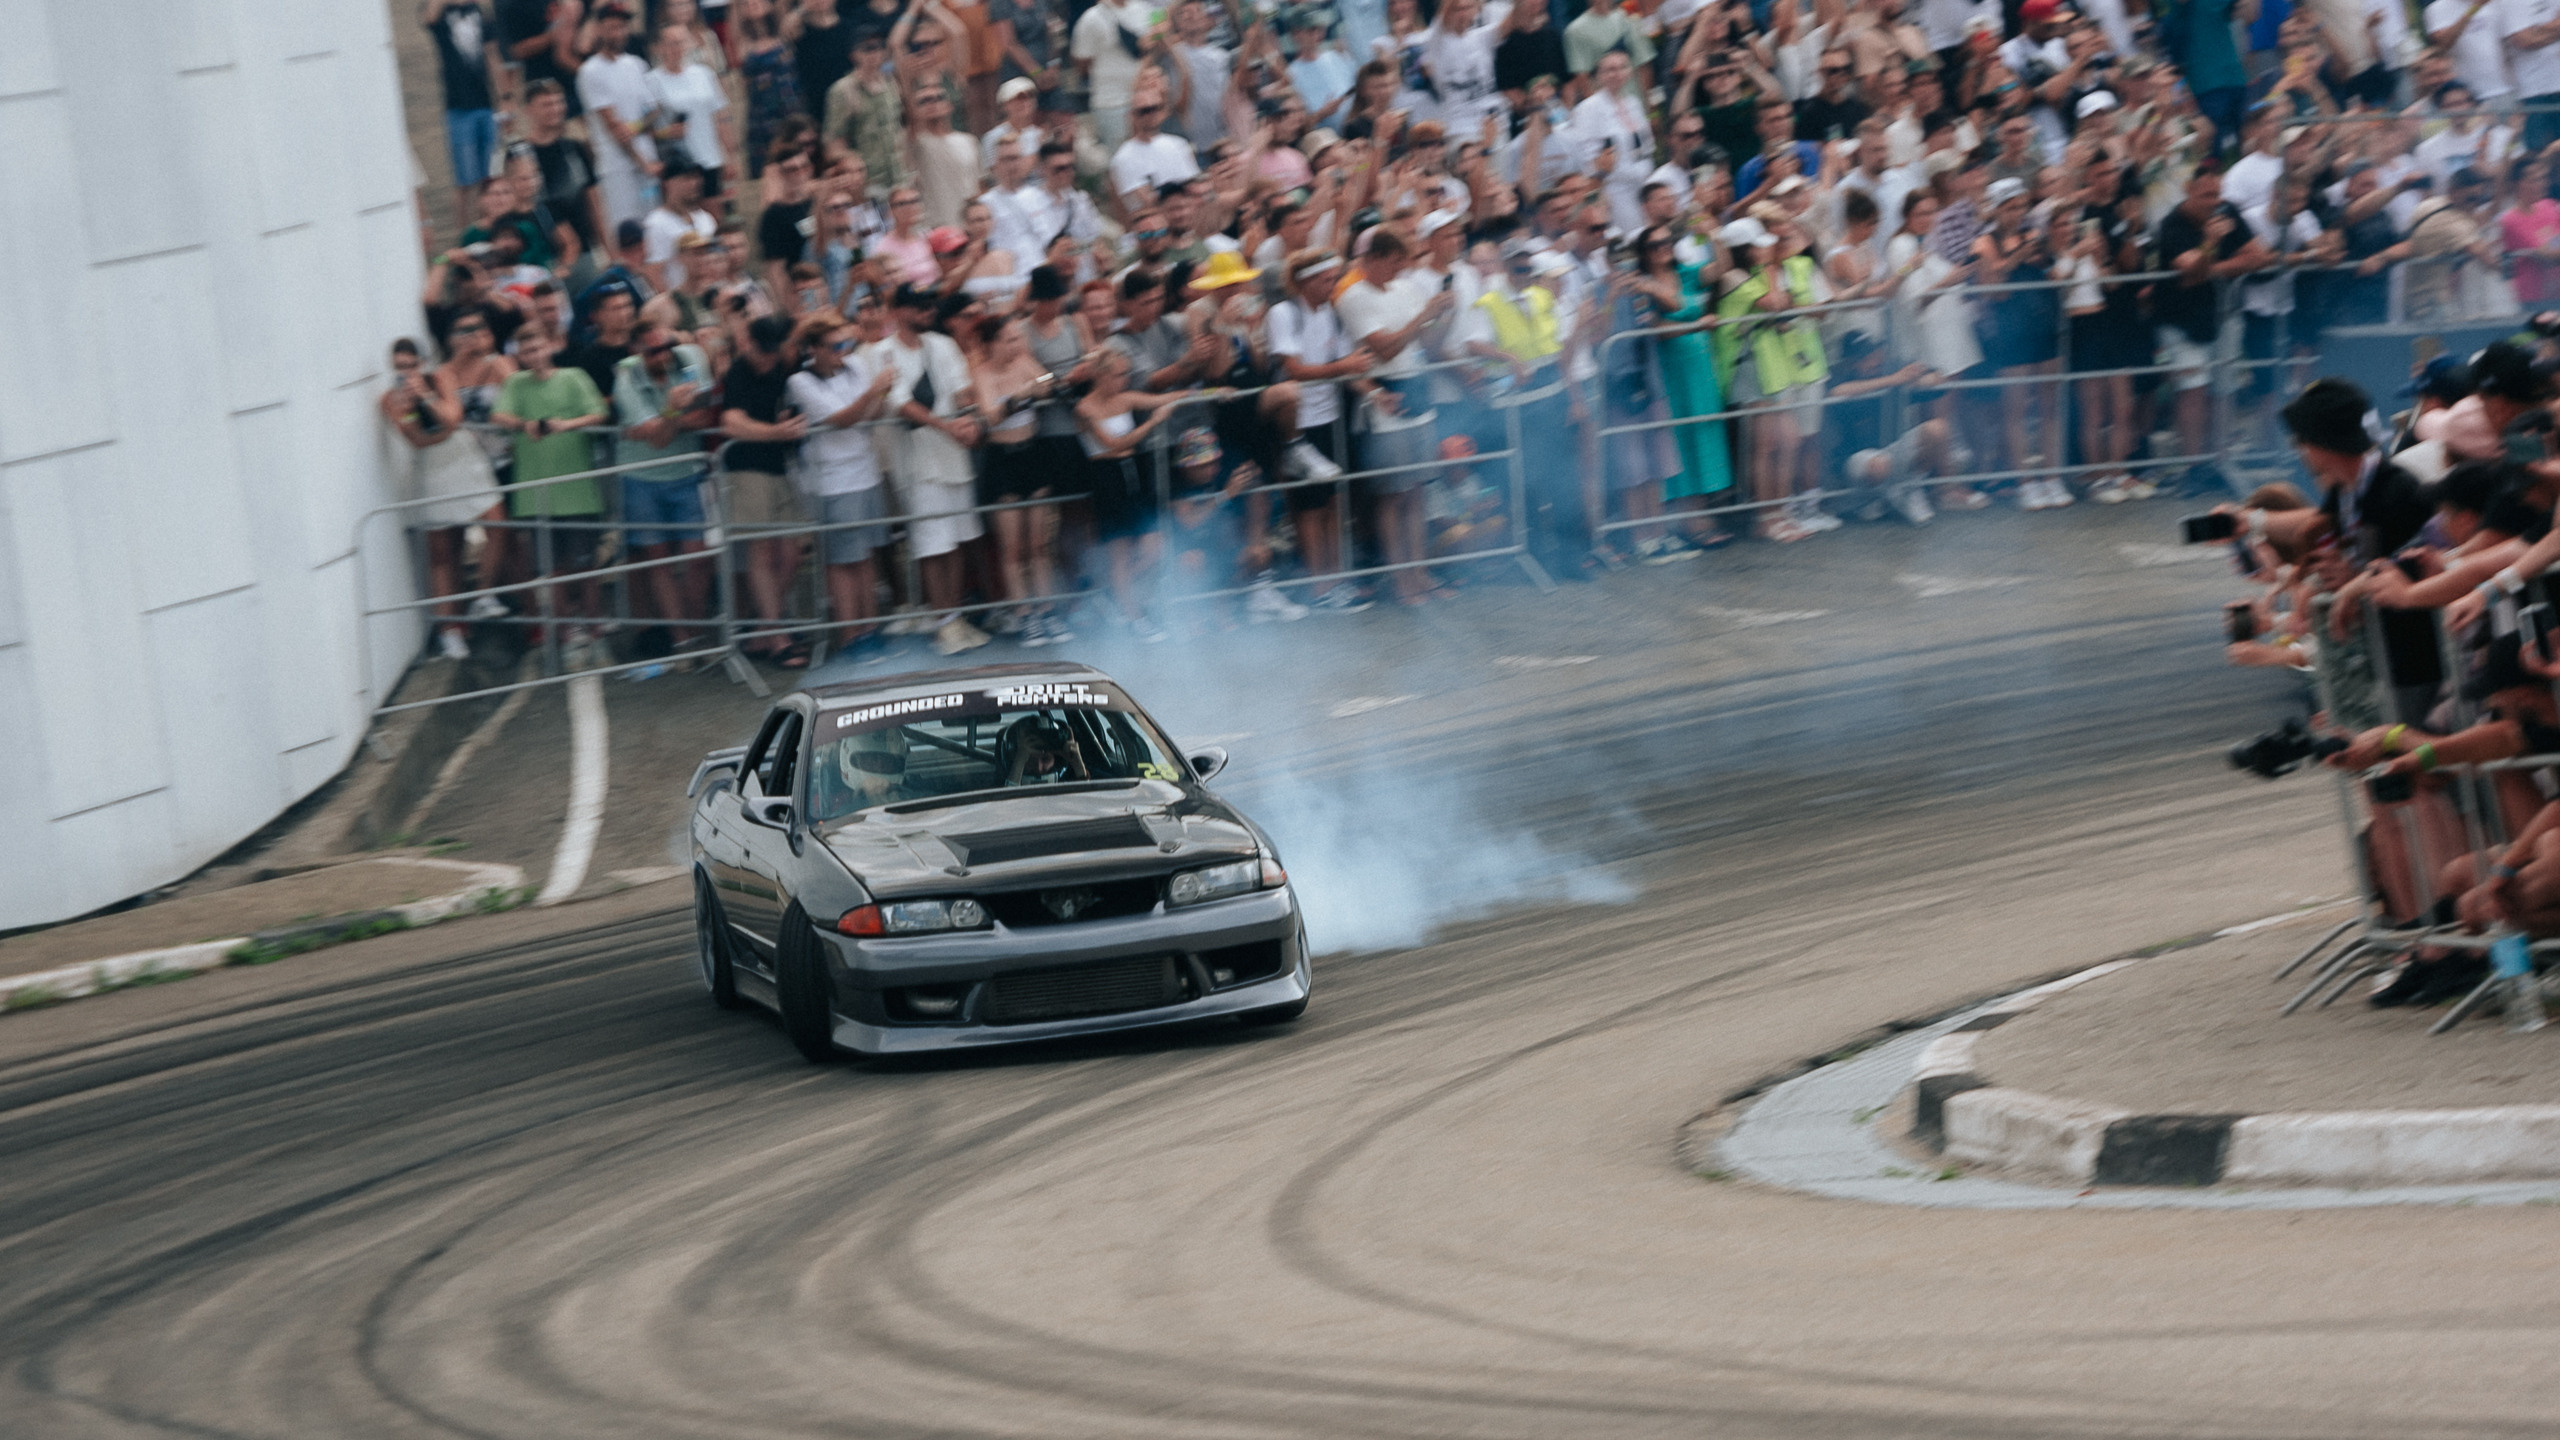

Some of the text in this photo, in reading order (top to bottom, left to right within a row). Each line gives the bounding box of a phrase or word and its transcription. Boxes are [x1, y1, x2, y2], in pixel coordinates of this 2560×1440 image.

[984, 683, 1090, 699] DRIFT
[997, 692, 1109, 707] FIGHTERS
[837, 693, 964, 729] GROUNDED
[1137, 762, 1179, 782] 28
